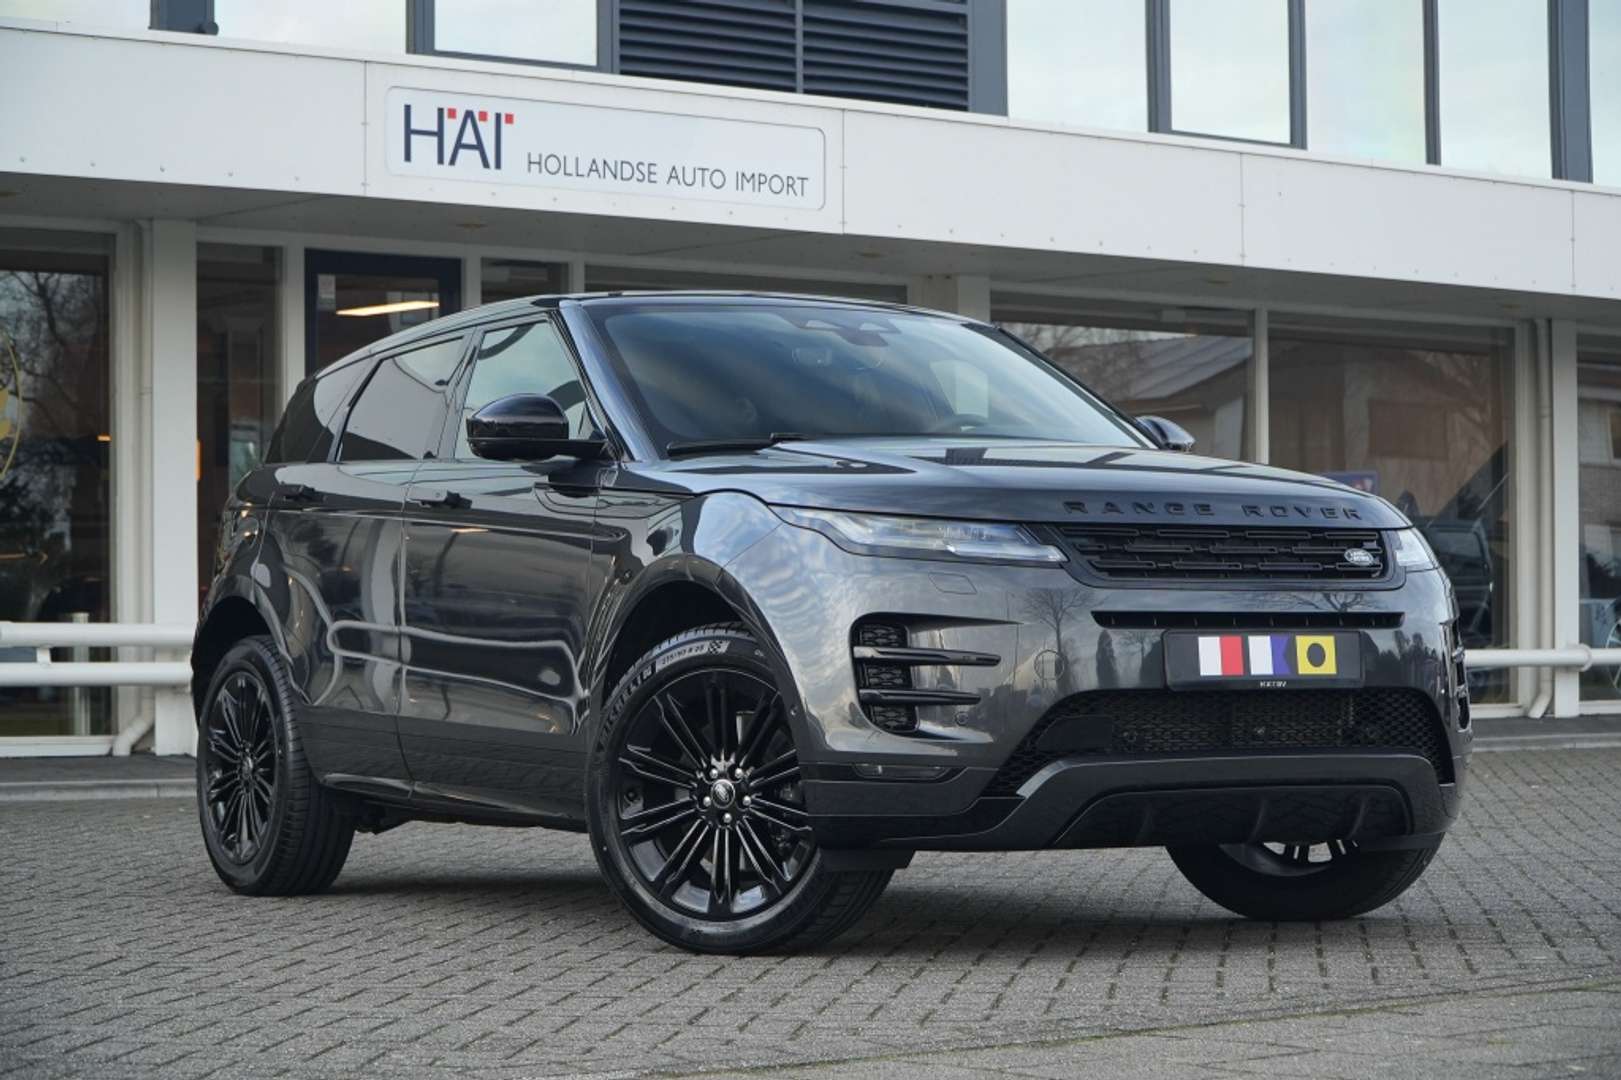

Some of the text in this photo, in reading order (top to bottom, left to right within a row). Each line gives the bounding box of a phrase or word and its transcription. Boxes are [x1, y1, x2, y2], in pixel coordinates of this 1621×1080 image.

[403, 104, 513, 170] HAI
[526, 152, 809, 198] HOLLANDSE AUTO IMPORT
[1063, 500, 1363, 521] RANGE ROVER
